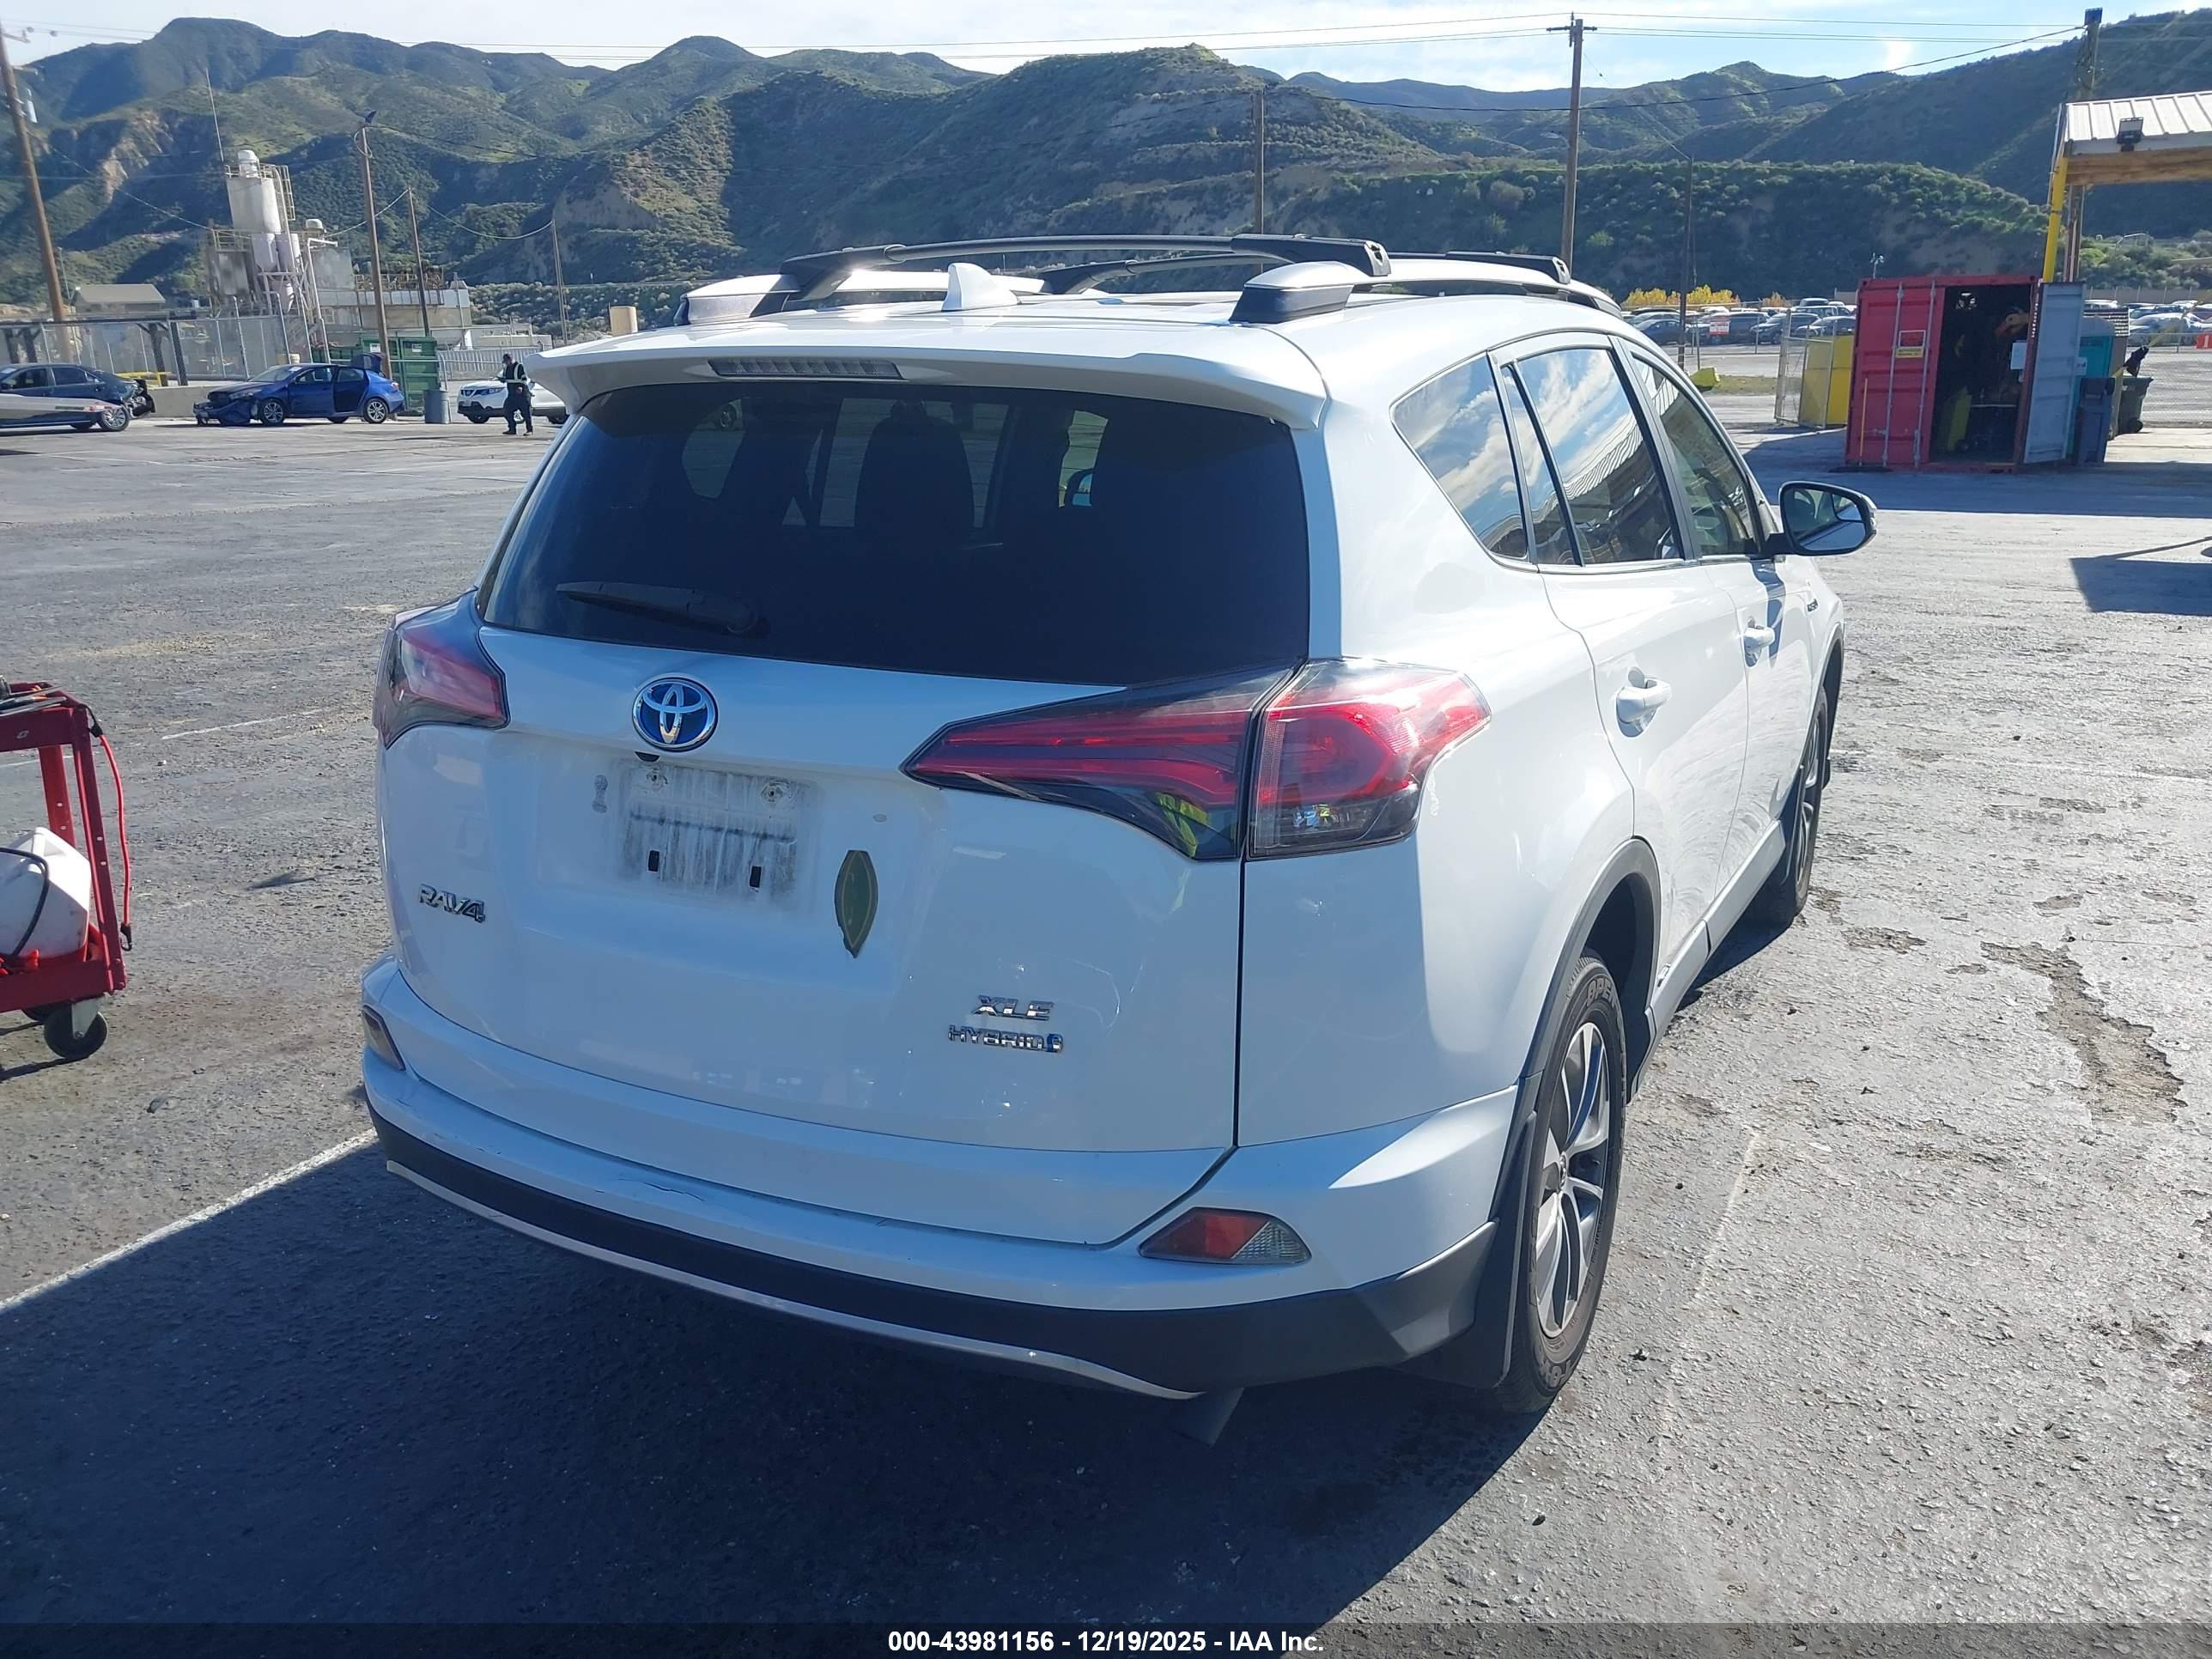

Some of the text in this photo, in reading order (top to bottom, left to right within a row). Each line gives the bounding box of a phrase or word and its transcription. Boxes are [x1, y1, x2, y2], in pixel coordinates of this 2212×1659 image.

[419, 883, 486, 923] RAV4
[970, 994, 1054, 1021] XLE
[947, 1024, 1045, 1051] HYBRID
